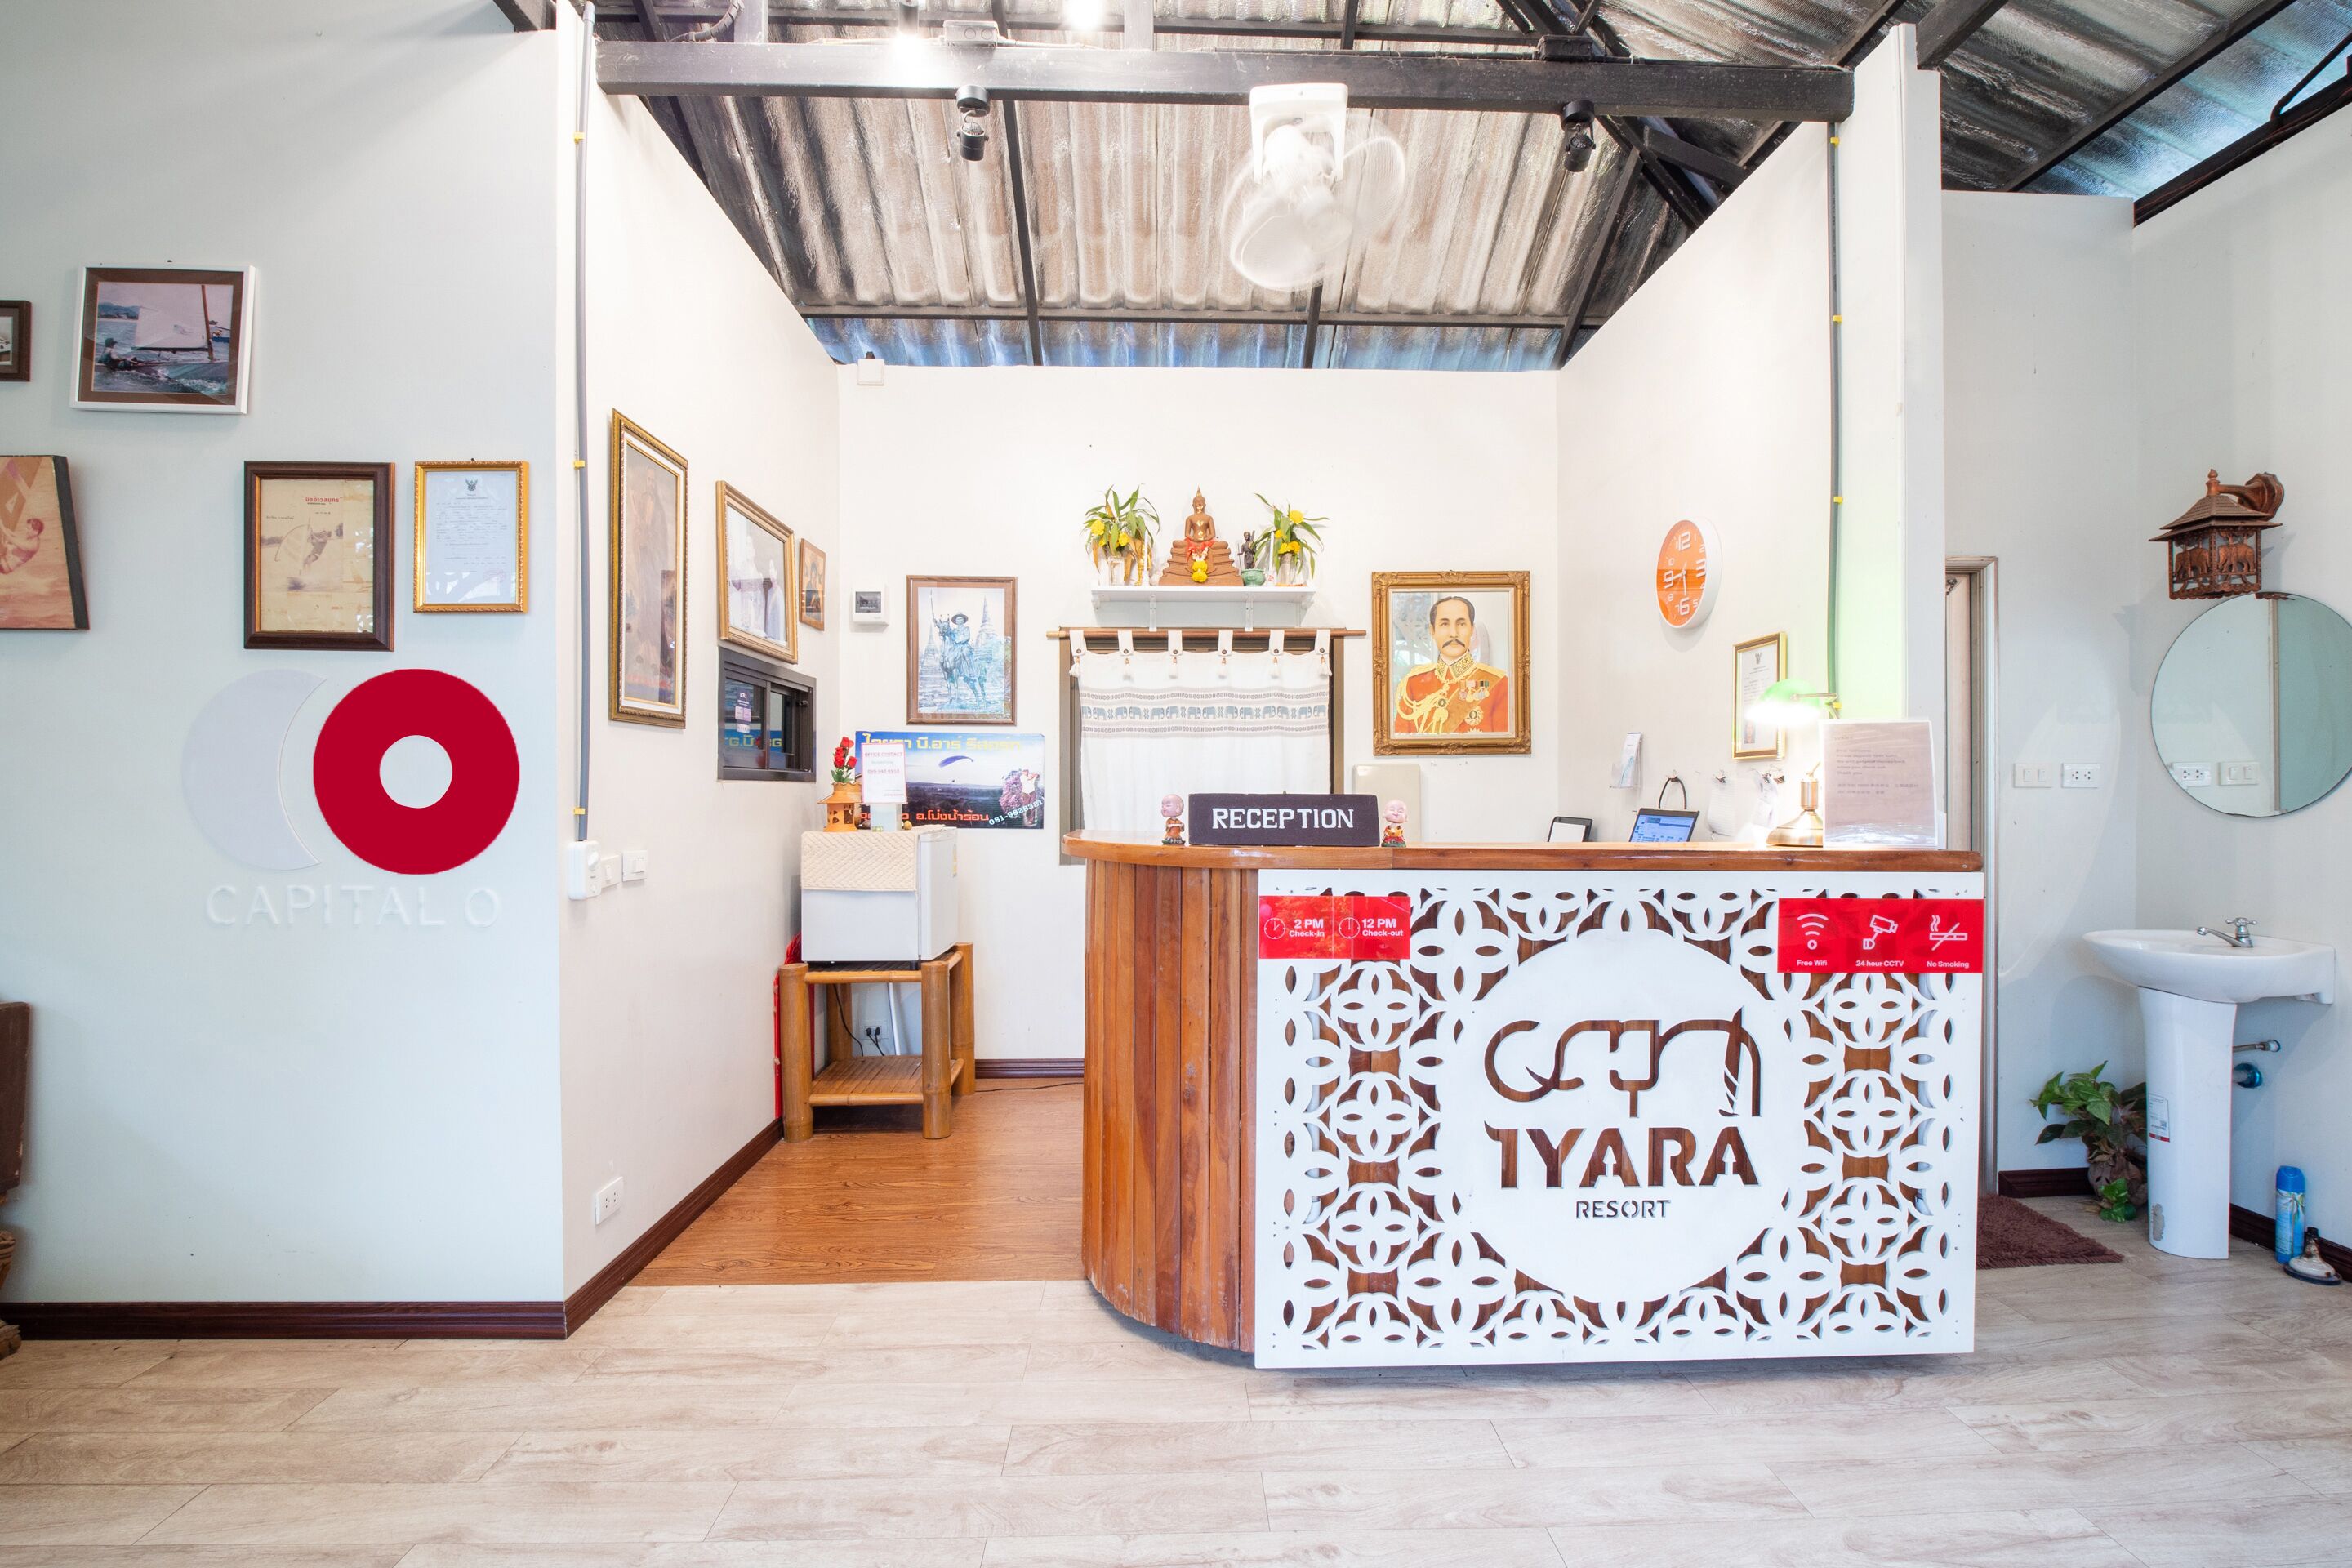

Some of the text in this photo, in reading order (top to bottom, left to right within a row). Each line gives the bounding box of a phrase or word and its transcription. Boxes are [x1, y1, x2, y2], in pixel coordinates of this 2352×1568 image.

[1678, 531, 1691, 551] 12
[1663, 570, 1674, 589] 9
[1680, 597, 1690, 616] 6
[916, 736, 961, 750] บี.อาร์
[1212, 808, 1354, 829] RECEPTION
[206, 884, 501, 929] CAPITAL O
[1294, 919, 1324, 929] 2 PM
[1361, 918, 1396, 929] 12 PM
[1289, 929, 1325, 938] Check-in
[1883, 960, 1904, 968] CCTV
[1938, 960, 1970, 969] Smoking
[1484, 1120, 1760, 1188] IYARA
[1576, 1199, 1672, 1218] RESORT
